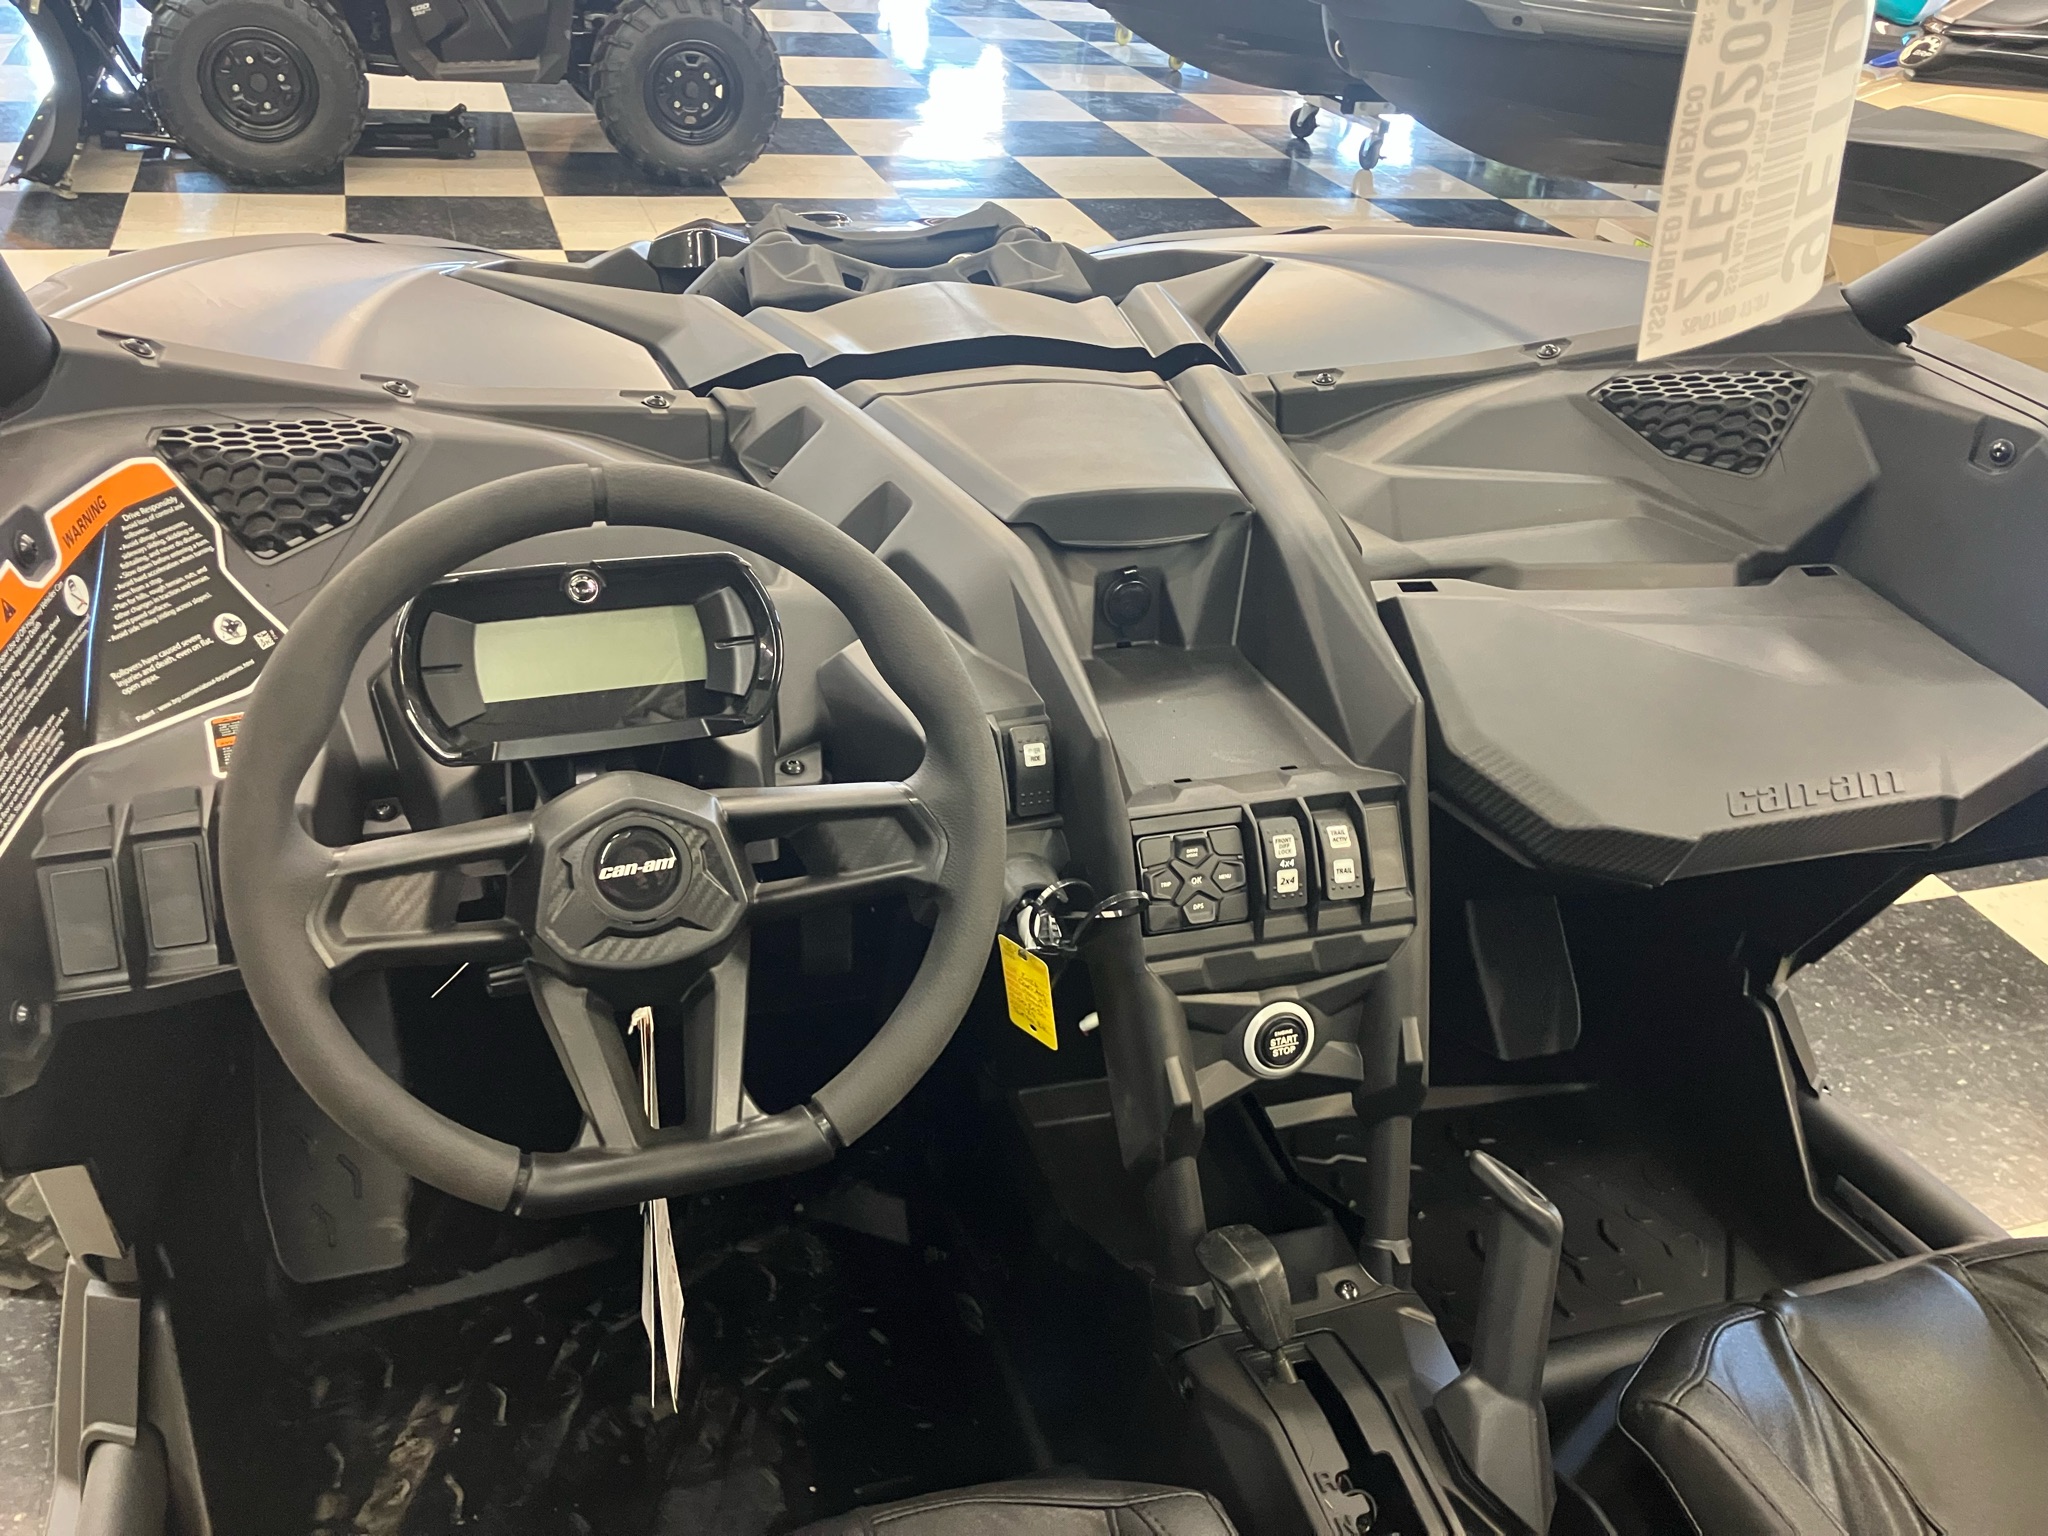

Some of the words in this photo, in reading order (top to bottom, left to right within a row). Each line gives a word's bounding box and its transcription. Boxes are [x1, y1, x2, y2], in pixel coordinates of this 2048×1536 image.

[121, 510, 140, 521] Drive
[139, 496, 177, 514] Responsibly
[62, 495, 107, 549] WARNING
[109, 662, 142, 679] Rollovers
[140, 654, 158, 665] have
[158, 642, 181, 657] caused
[180, 634, 201, 646] severe
[141, 663, 155, 675] and
[175, 648, 192, 658] even
[1727, 771, 1905, 817] can-am
[598, 856, 677, 880] can-am
[1279, 858, 1295, 868] 4x4
[1191, 876, 1202, 885] OK
[1280, 877, 1295, 886] 2x4
[1192, 903, 1204, 911] DPS
[1270, 1033, 1299, 1047] START
[1272, 1045, 1296, 1058] STOP
[1313, 1472, 1338, 1494] R
